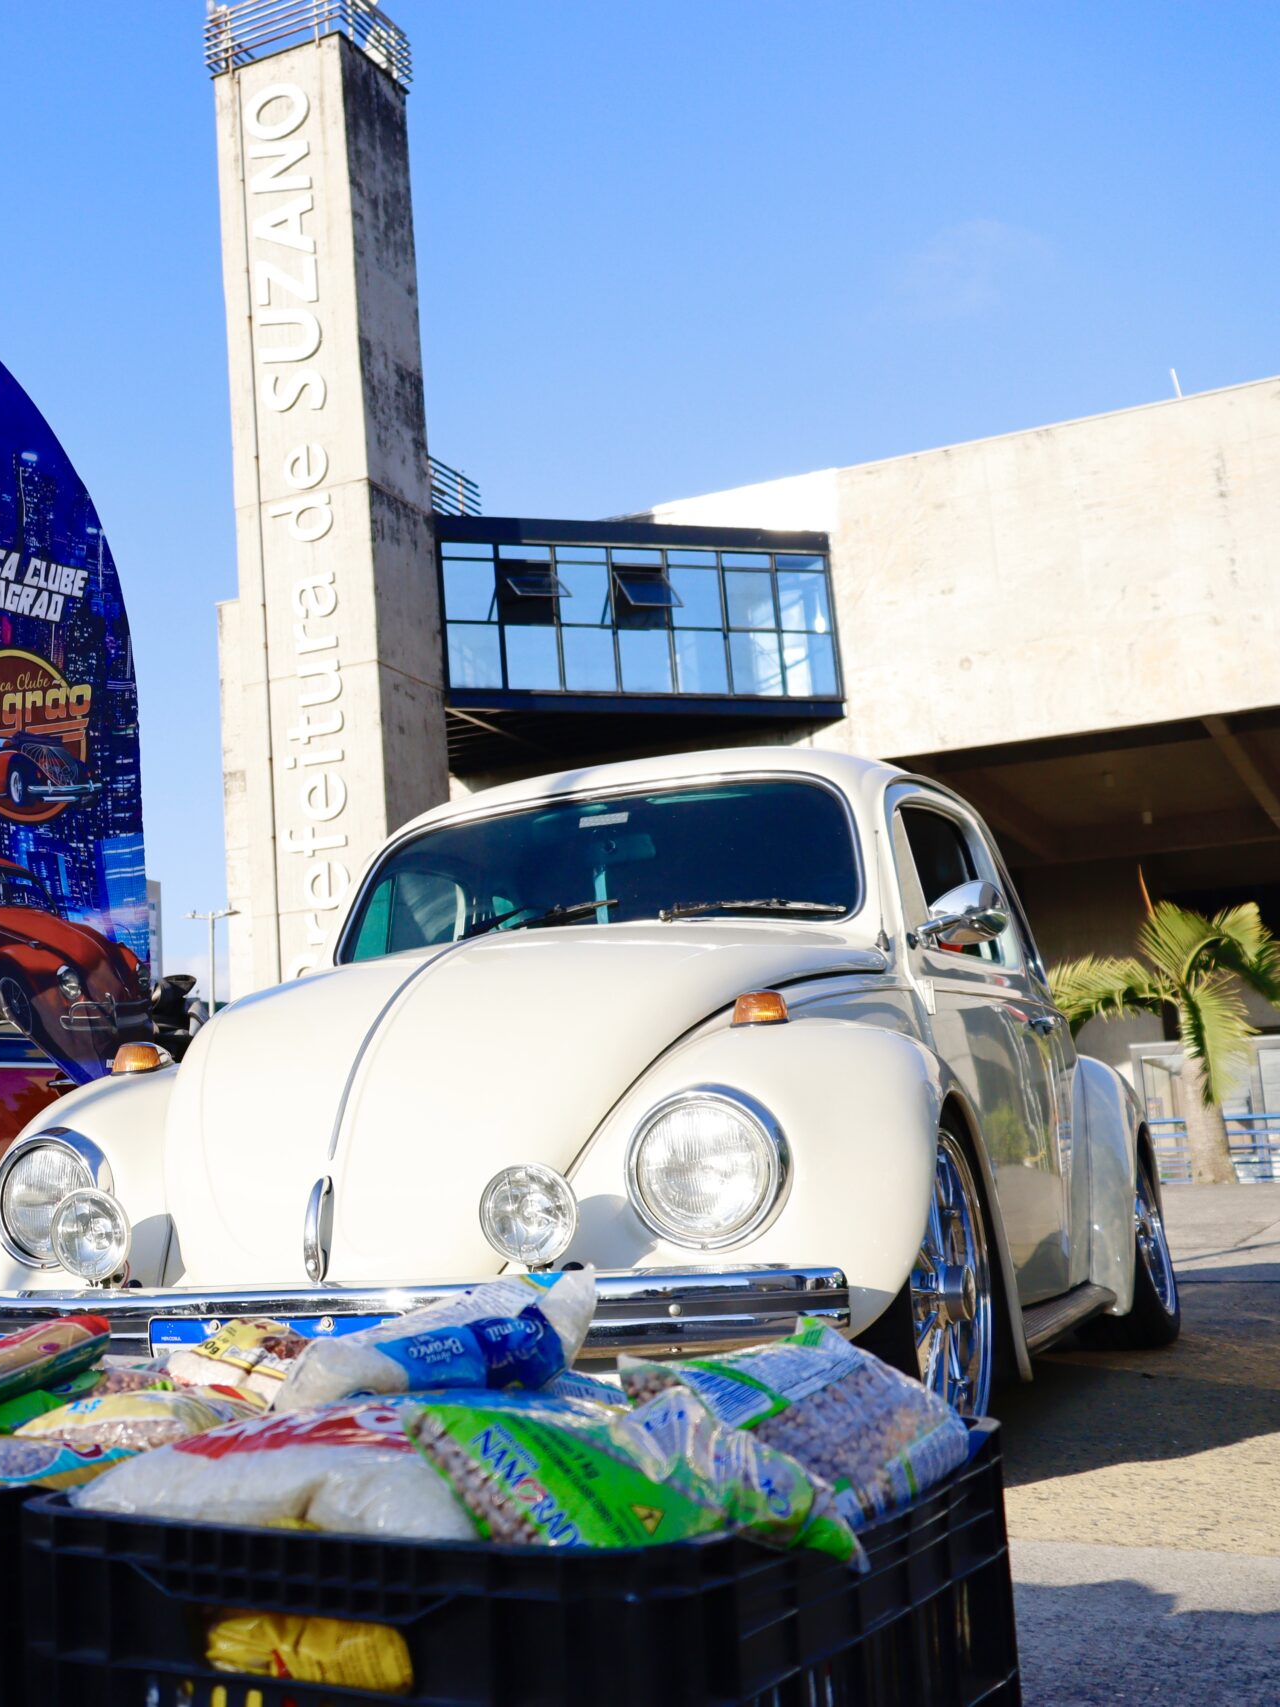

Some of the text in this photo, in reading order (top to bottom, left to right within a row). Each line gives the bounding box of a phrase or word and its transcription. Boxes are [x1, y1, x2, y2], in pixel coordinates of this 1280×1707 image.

[243, 82, 350, 978] refeitura de SUZANO
[24, 557, 88, 597] CLUBE
[17, 670, 50, 691] Clube
[485, 1318, 537, 1342] Camil
[407, 1335, 465, 1359] Branco
